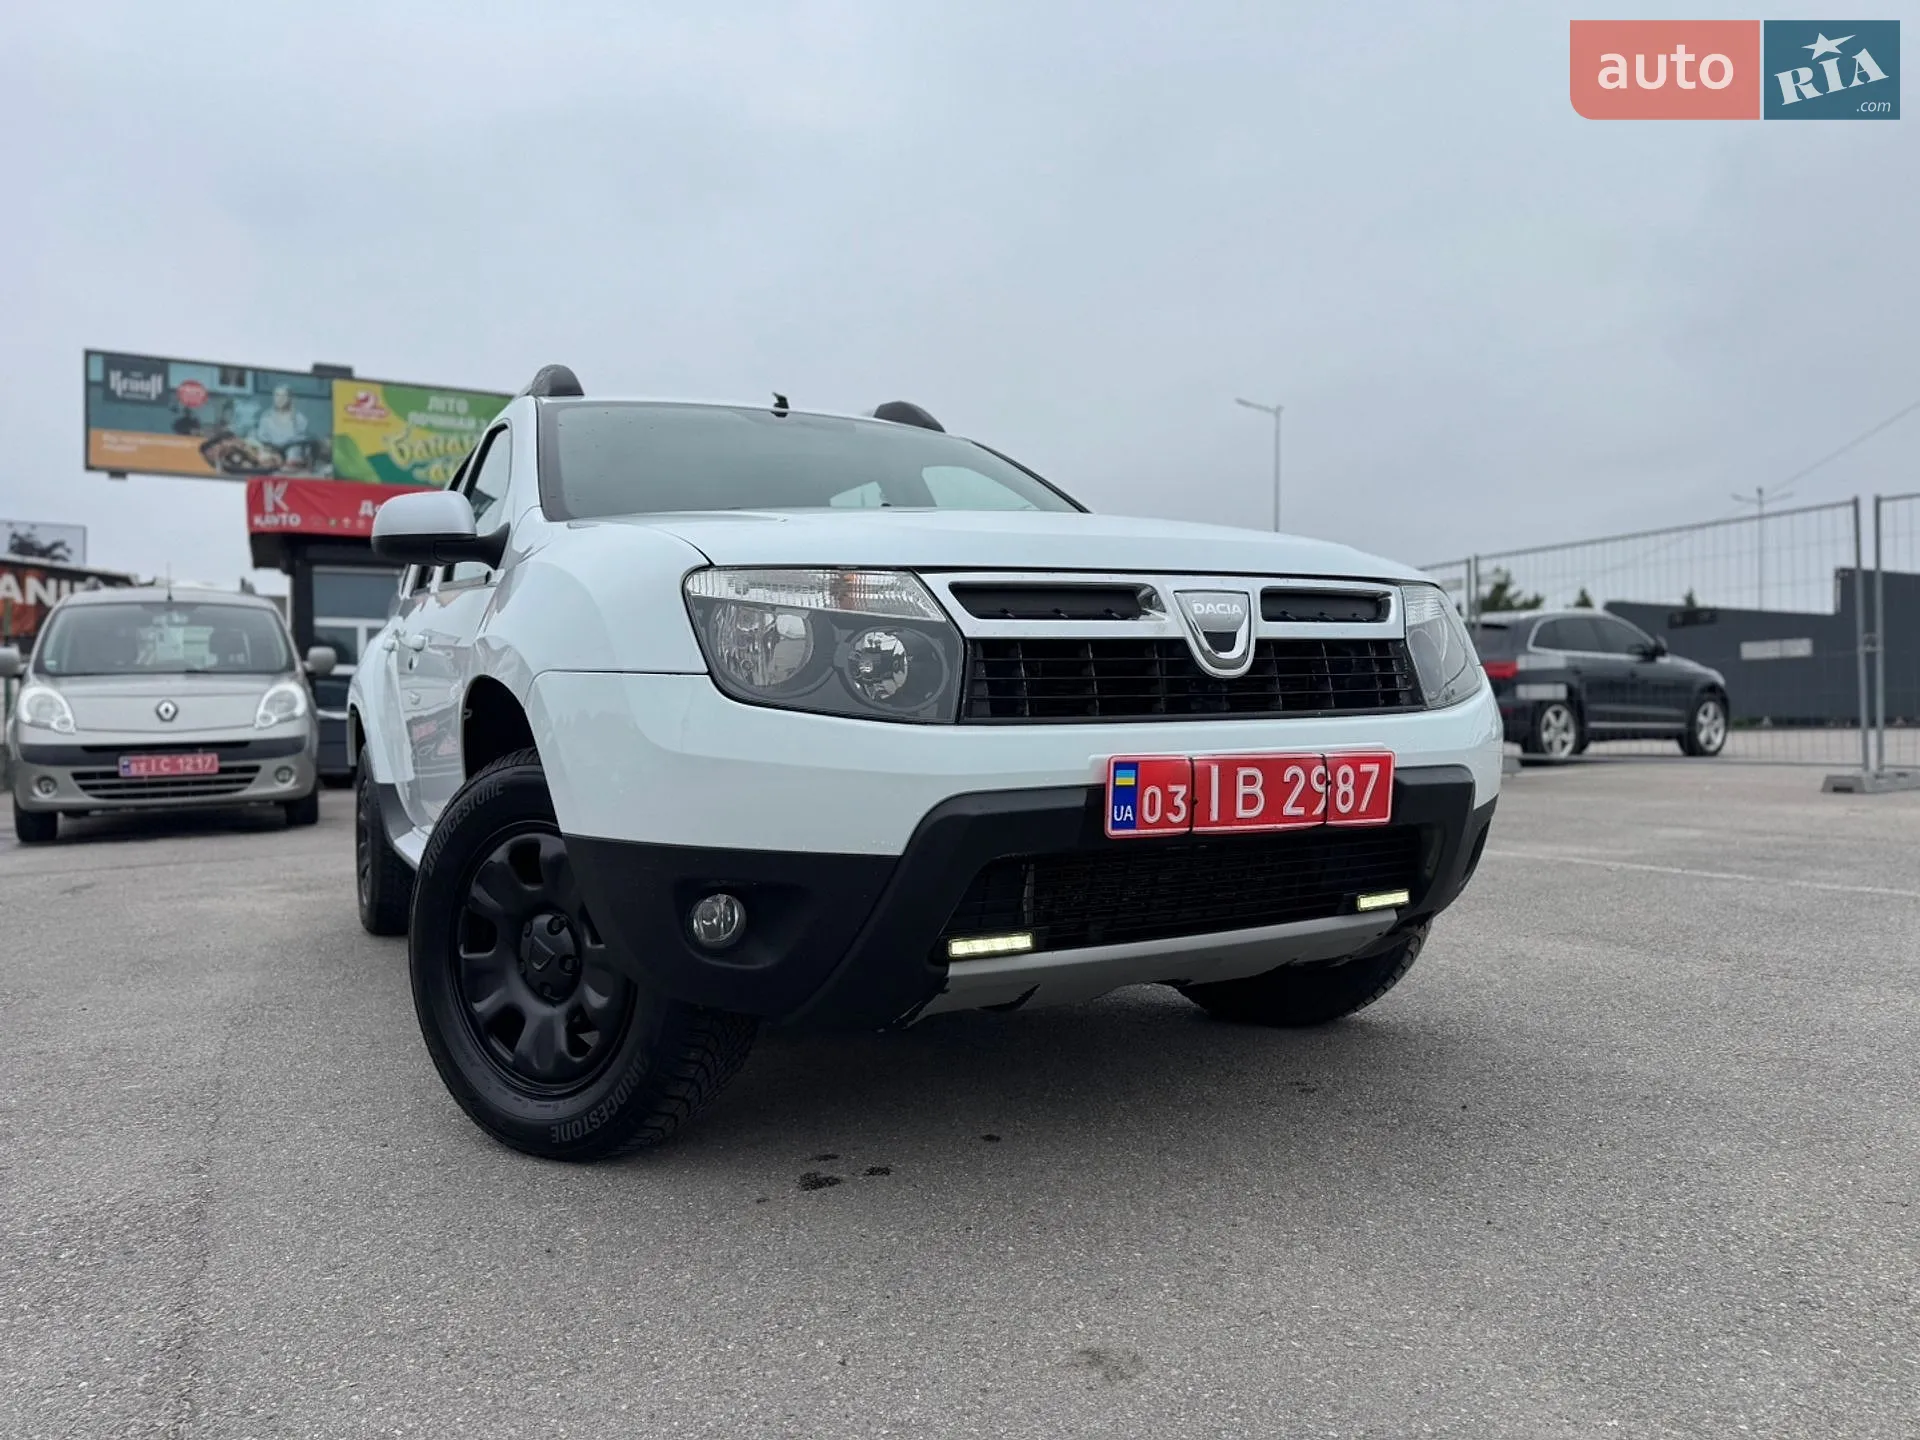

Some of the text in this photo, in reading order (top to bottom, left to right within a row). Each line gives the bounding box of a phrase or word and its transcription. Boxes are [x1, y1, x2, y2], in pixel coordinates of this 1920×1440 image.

[1191, 602, 1243, 615] DACIA
[1142, 762, 1380, 824] 03 IB 2987
[1113, 804, 1135, 823] UA
[549, 1047, 650, 1144] BRIDGESTONE
